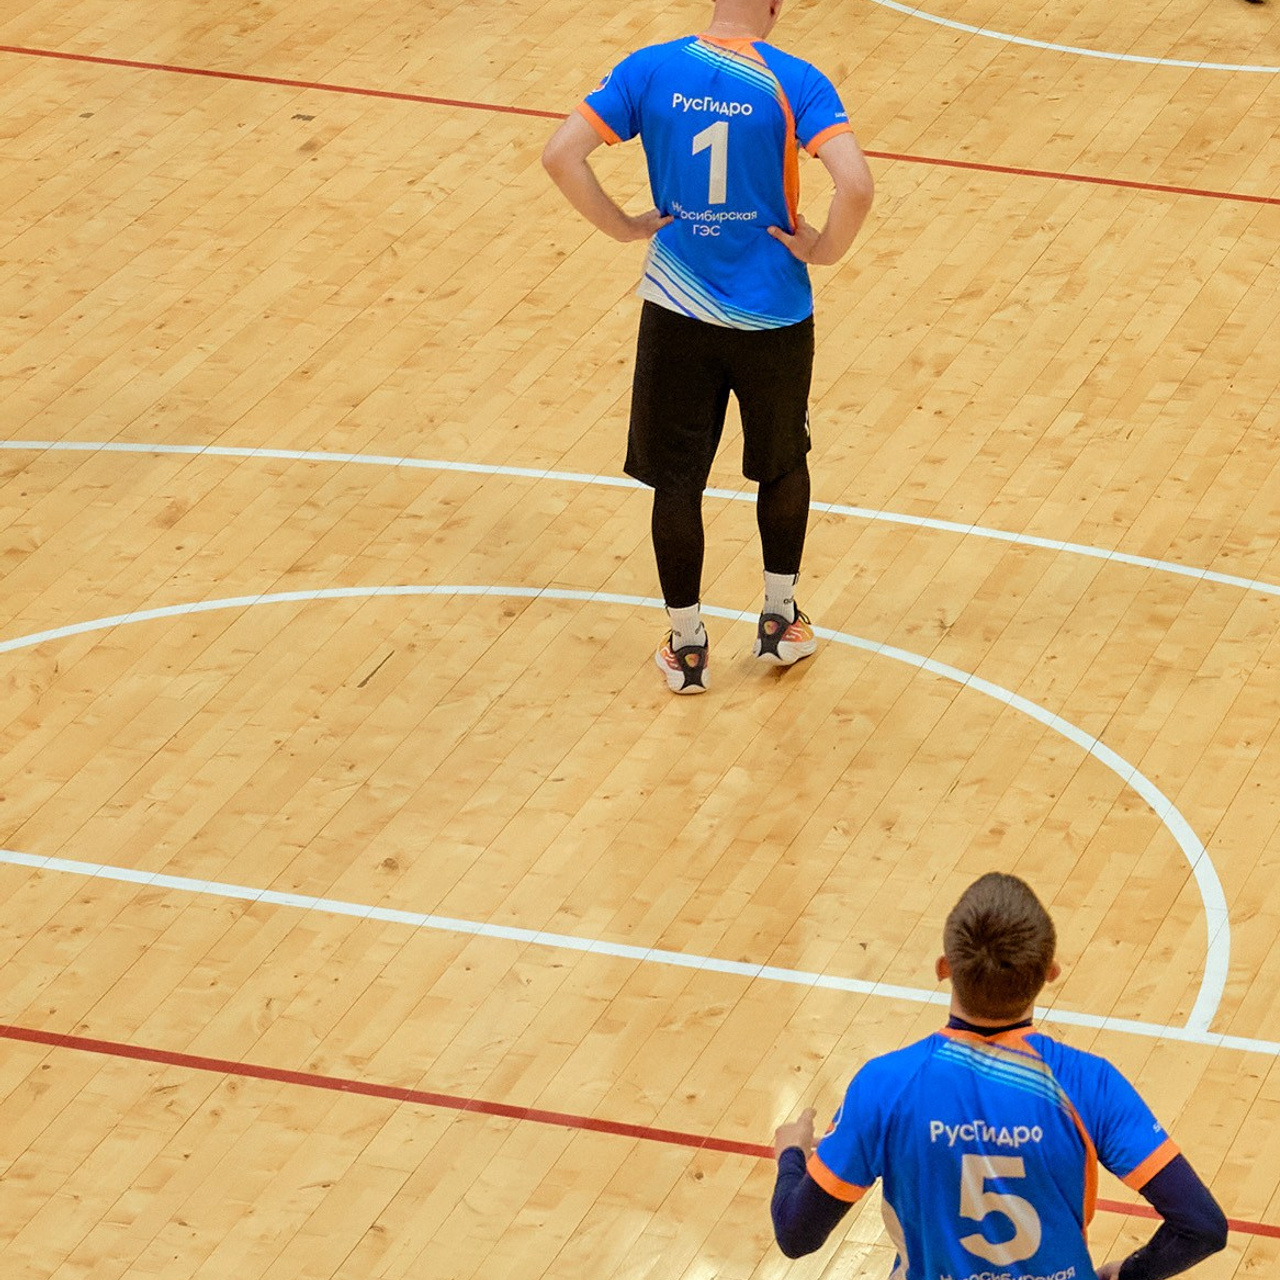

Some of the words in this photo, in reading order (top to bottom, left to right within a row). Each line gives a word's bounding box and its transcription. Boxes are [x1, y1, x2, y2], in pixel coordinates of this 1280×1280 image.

[672, 93, 753, 117] РусГидро
[692, 120, 729, 205] 1
[671, 200, 758, 223] Носибирская
[692, 224, 721, 237] ГЭС
[930, 1119, 1043, 1148] РусГидро
[959, 1153, 1042, 1267] 5
